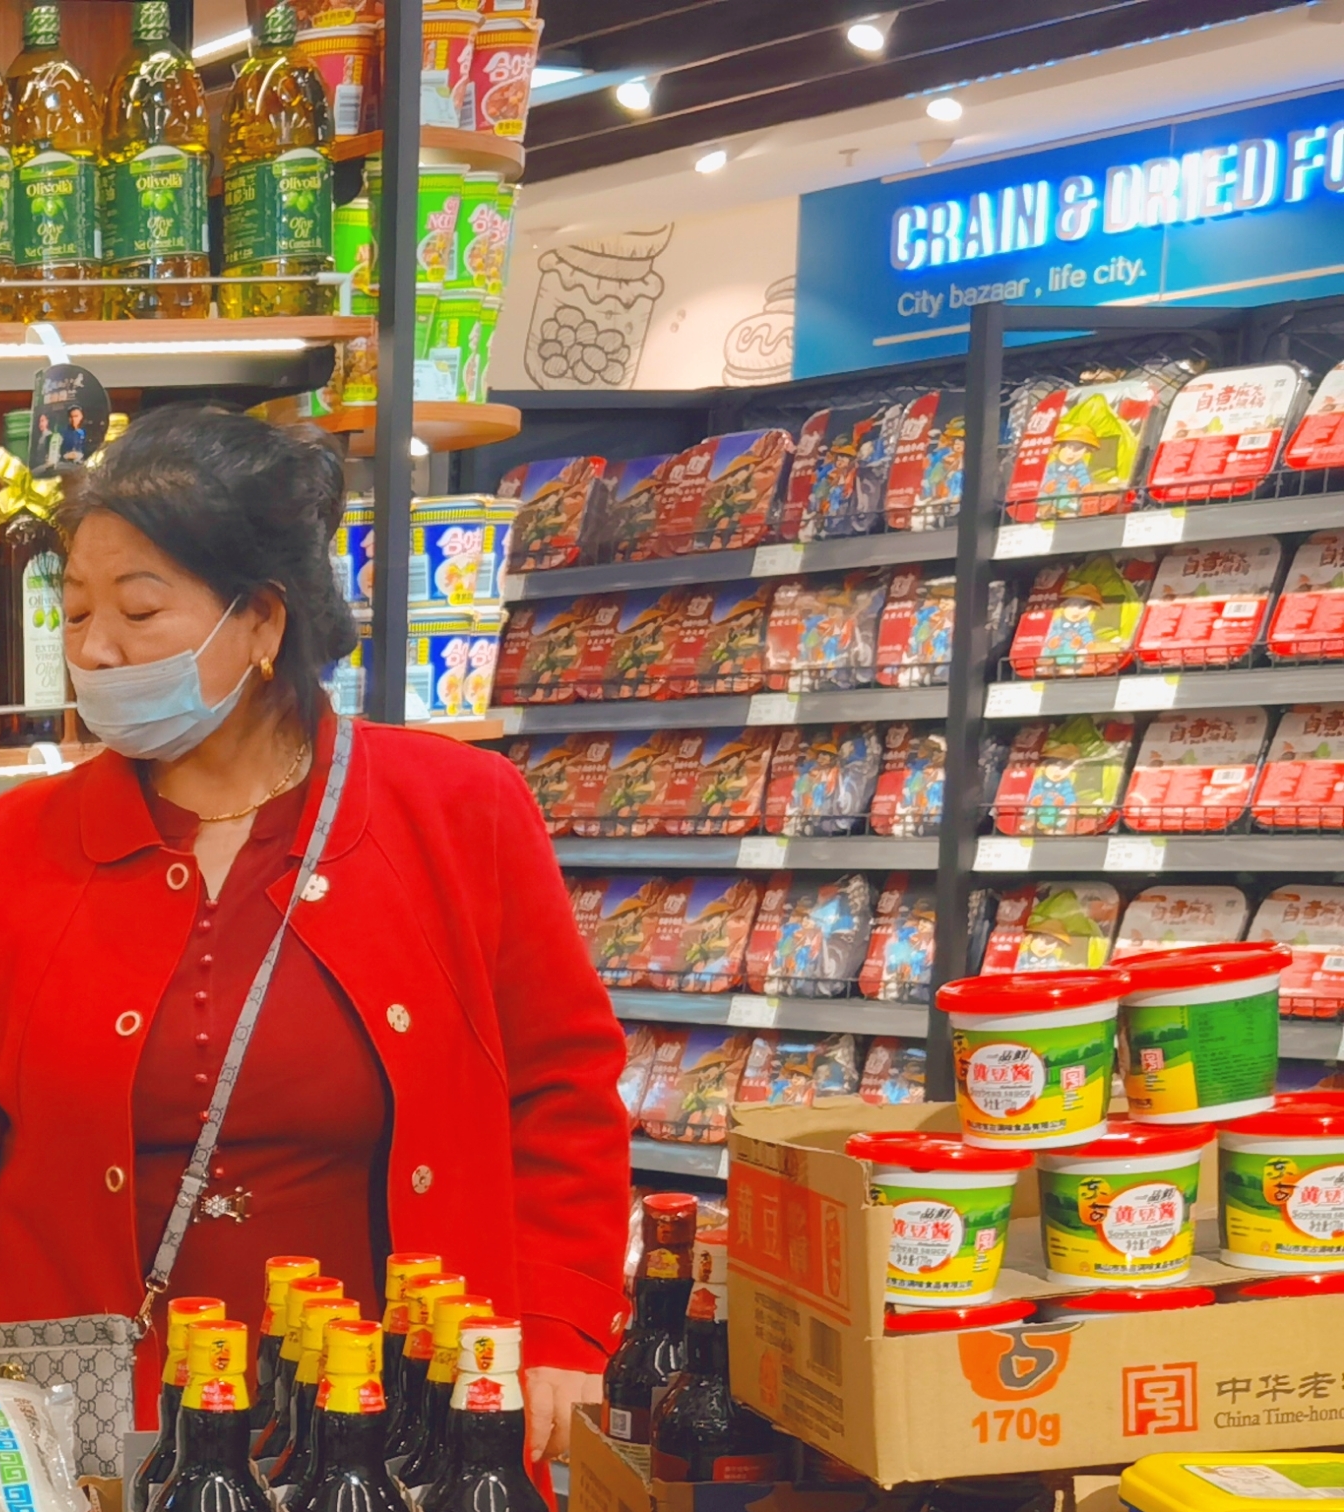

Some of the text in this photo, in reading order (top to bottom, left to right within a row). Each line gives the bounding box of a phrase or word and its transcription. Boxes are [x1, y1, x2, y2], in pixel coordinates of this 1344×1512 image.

[1056, 174, 1098, 241] &
[1104, 138, 1279, 234] DRIED
[897, 291, 942, 319] City
[949, 276, 1031, 308] bazaar
[1048, 264, 1087, 293] life
[972, 1061, 1035, 1084] 黄豆酱
[1114, 1201, 1177, 1226] 黄豆酱
[1215, 1371, 1344, 1404] 中华老
[971, 1407, 1062, 1447] 170g
[1213, 1411, 1260, 1430] China
